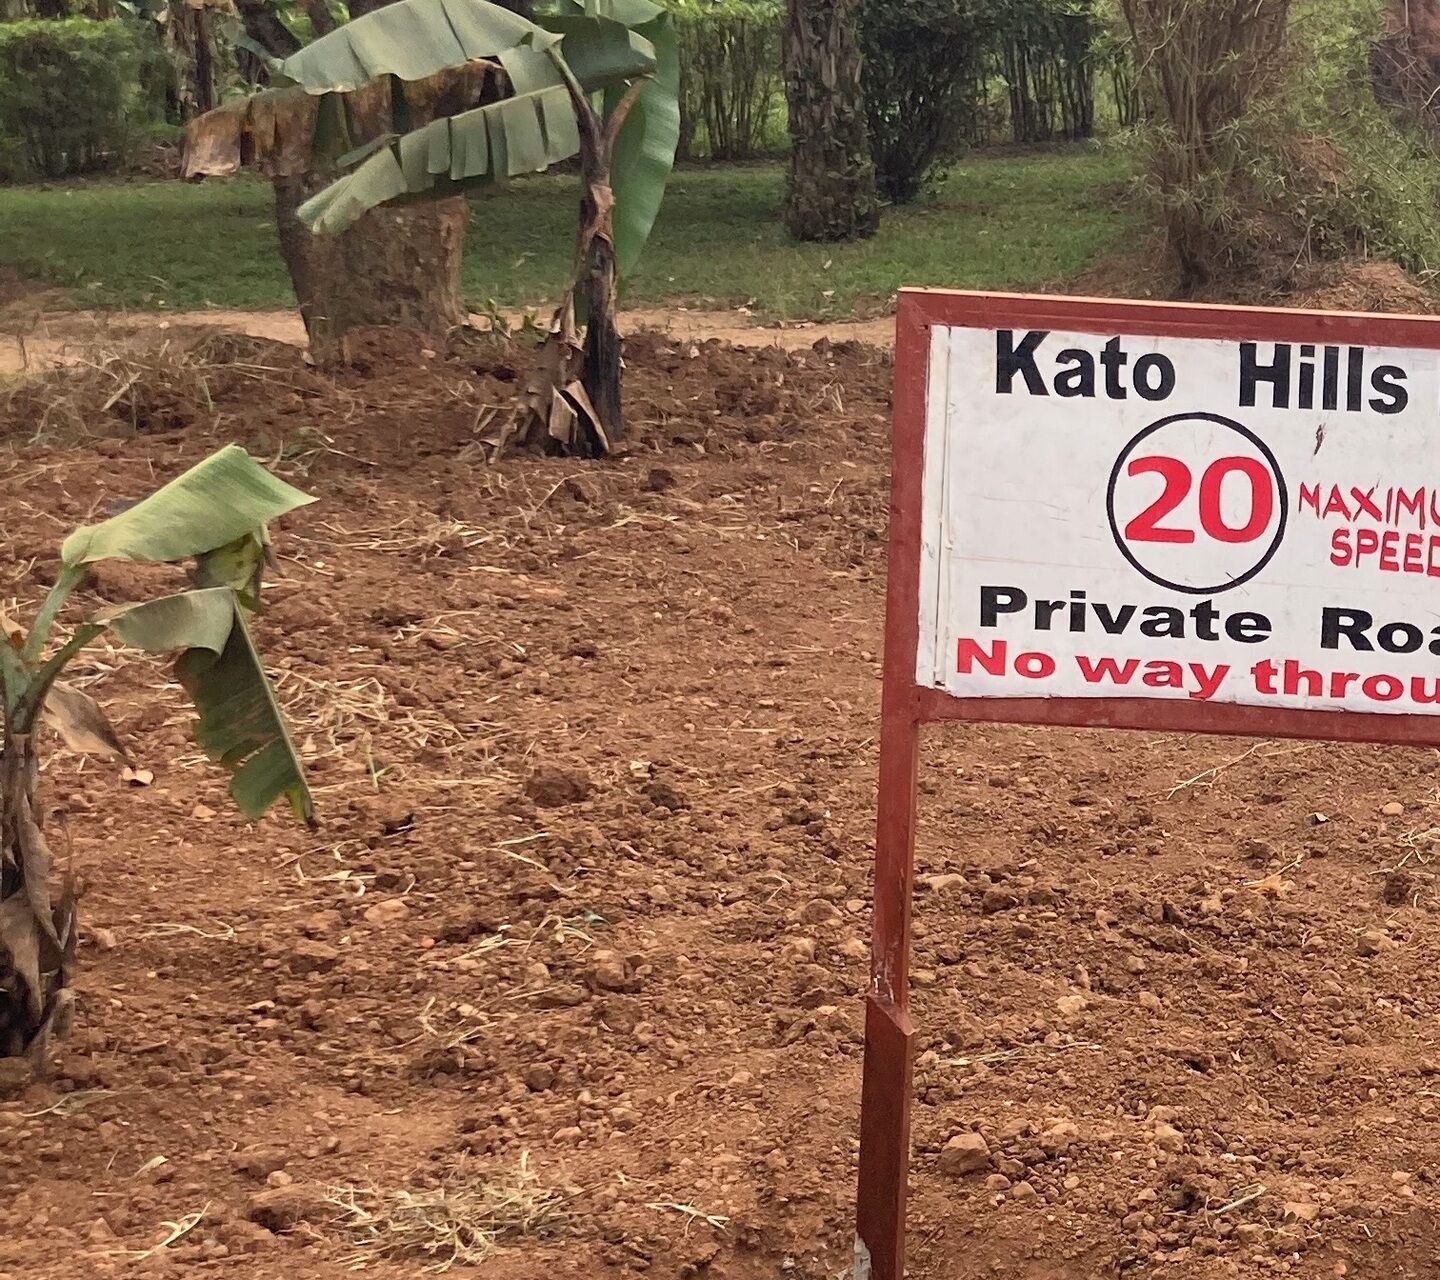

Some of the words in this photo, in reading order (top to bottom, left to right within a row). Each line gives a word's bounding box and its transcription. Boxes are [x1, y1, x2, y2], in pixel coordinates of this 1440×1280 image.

[995, 330, 1176, 401] Kato
[1238, 342, 1409, 414] Hills
[1125, 455, 1274, 544] 20
[979, 586, 1272, 643] Private
[956, 637, 1055, 679] No
[1075, 656, 1229, 699] way
